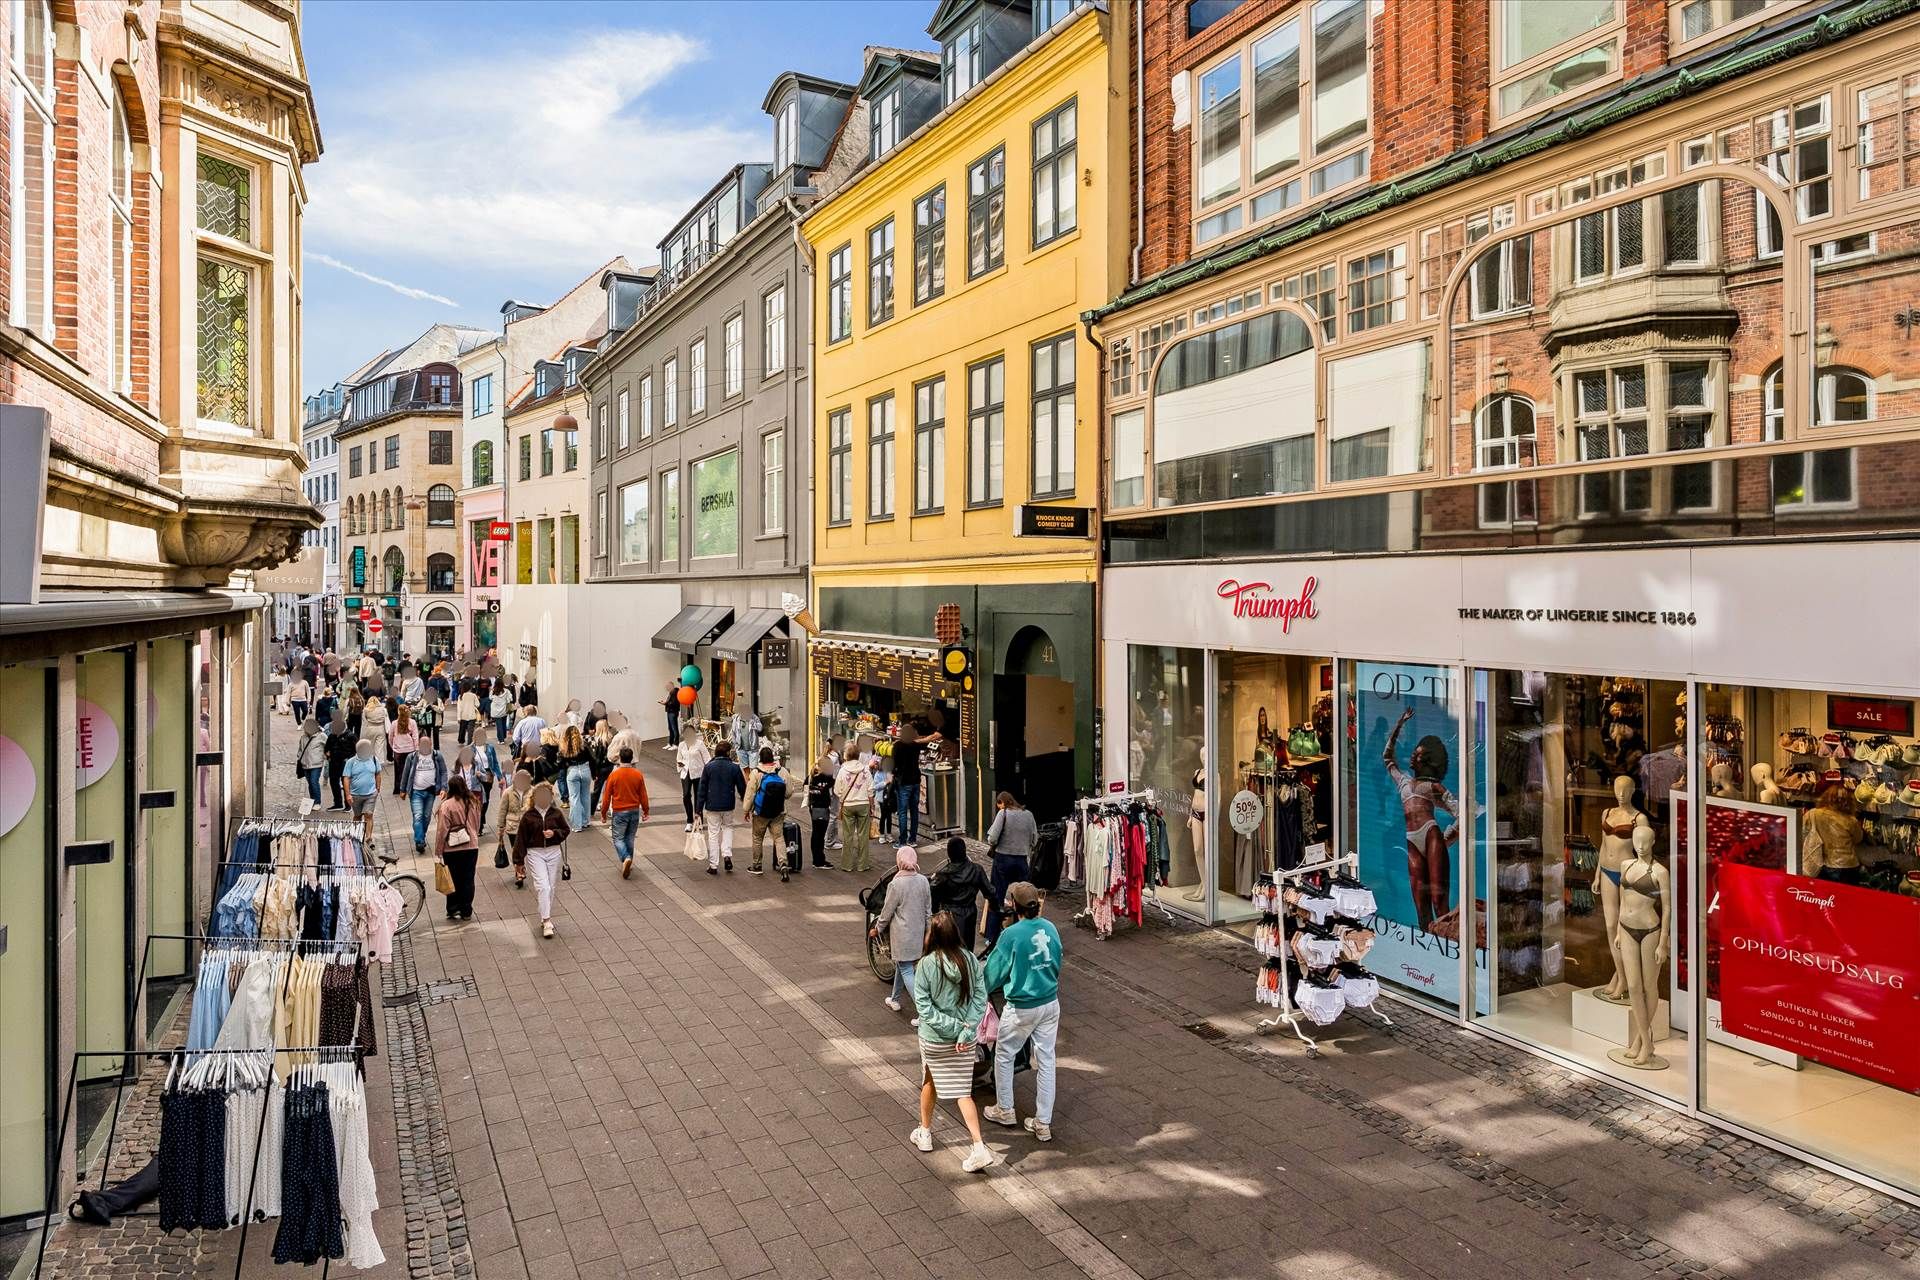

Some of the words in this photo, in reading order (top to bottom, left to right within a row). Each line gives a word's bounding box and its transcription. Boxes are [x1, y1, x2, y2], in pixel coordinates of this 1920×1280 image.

[701, 490, 735, 512] BERSHKA
[493, 527, 508, 535] LEGO
[354, 548, 364, 584] WEEKDAY
[265, 576, 315, 585] MESSAGE
[1217, 576, 1319, 634] Triumph
[1458, 608, 1480, 619] THE
[1482, 608, 1524, 621] MAKER
[1526, 609, 1543, 621] OF
[1546, 609, 1609, 623] LINGERIE
[1612, 611, 1657, 624] SINCE
[1660, 611, 1697, 626] 1886
[1041, 646, 1054, 663] 41
[1373, 673, 1415, 700] OP
[1856, 711, 1883, 721] SALE
[1236, 801, 1257, 813] 50%
[1237, 811, 1256, 824] OFF
[1787, 886, 1836, 910] Triumph
[1411, 925, 1490, 970] RABT
[1732, 936, 1904, 989] OPHØRSUDSALG
[1400, 963, 1436, 986] Triumph
[1777, 1000, 1819, 1018] BUTIKKEN
[1821, 1012, 1856, 1028] LUKKER
[1760, 1009, 1796, 1025] SØNDAG
[1809, 1023, 1820, 1032] 14.
[1822, 1027, 1875, 1049] SEPTEMBER
